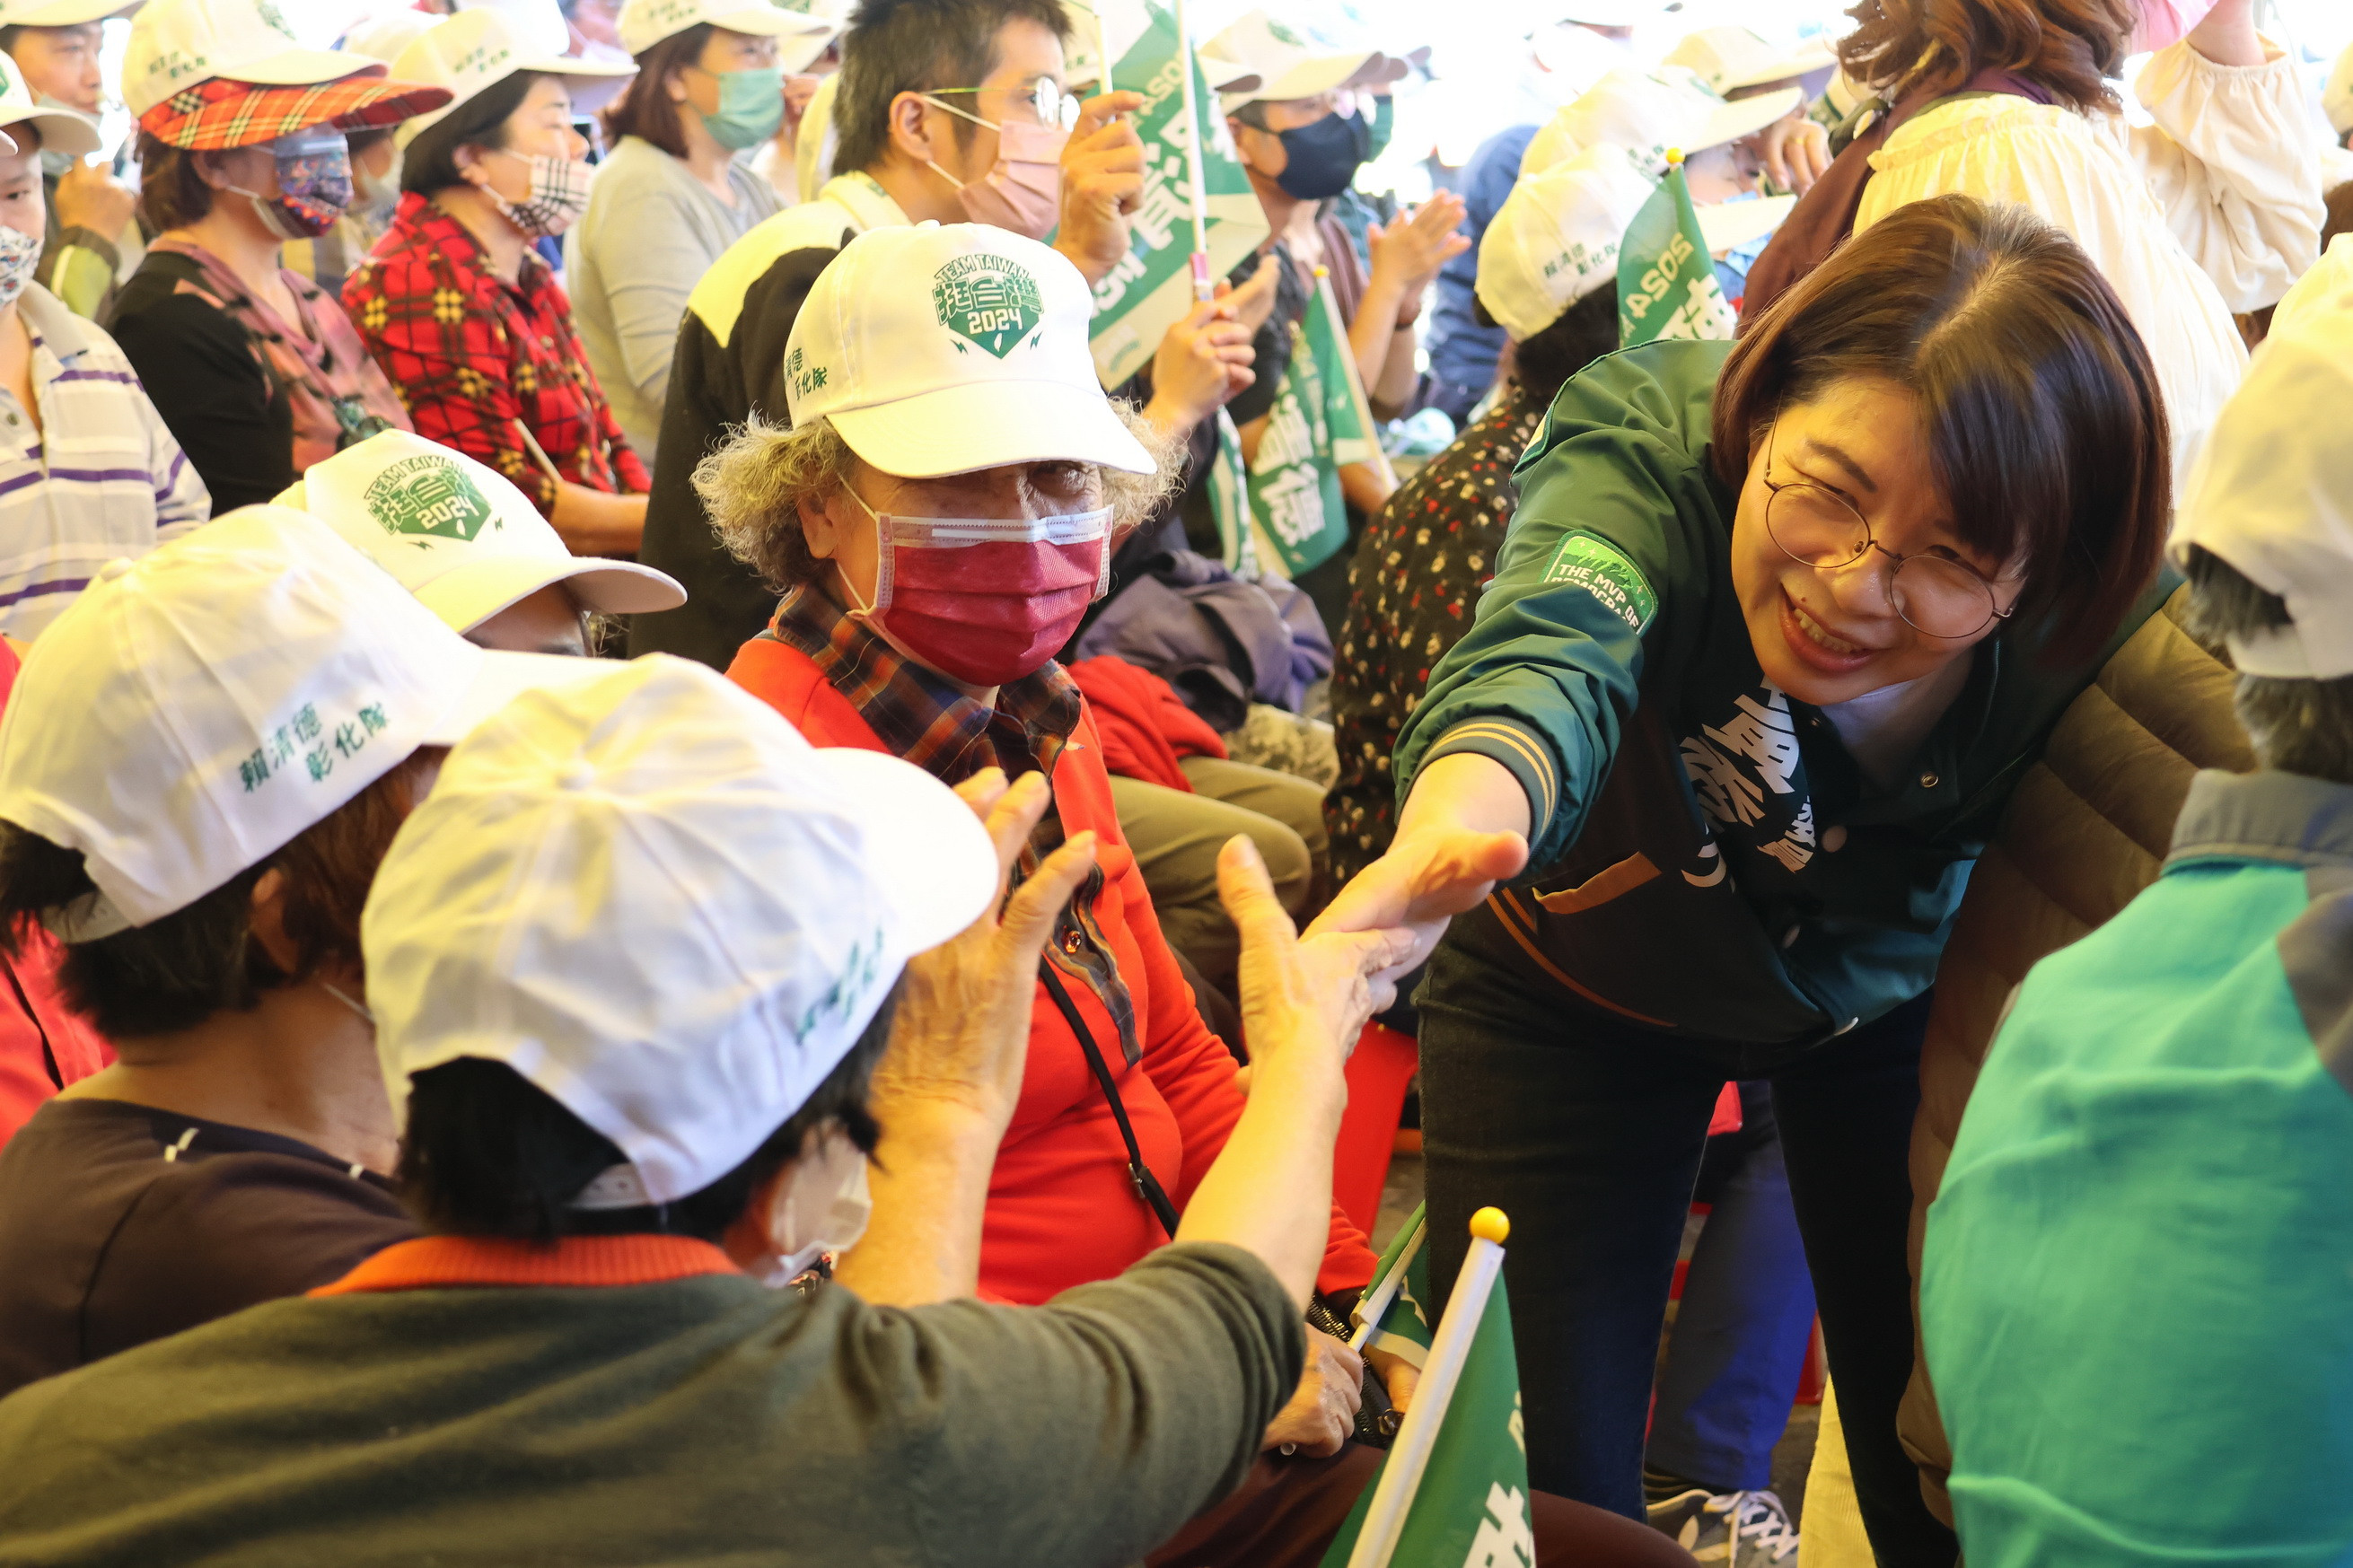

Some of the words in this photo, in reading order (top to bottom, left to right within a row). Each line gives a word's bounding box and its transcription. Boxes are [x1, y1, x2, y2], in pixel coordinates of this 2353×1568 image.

[934, 255, 977, 282] TEAM
[975, 253, 1032, 279] TAIWAN
[967, 308, 1023, 335] 2024
[364, 464, 407, 500] TEAM
[416, 495, 480, 530] 2024
[1558, 564, 1594, 581] THE
[1594, 573, 1627, 604] MVP
[1624, 604, 1639, 627] OF
[238, 702, 322, 793] 賴清德
[305, 701, 391, 783] 彰化隊
